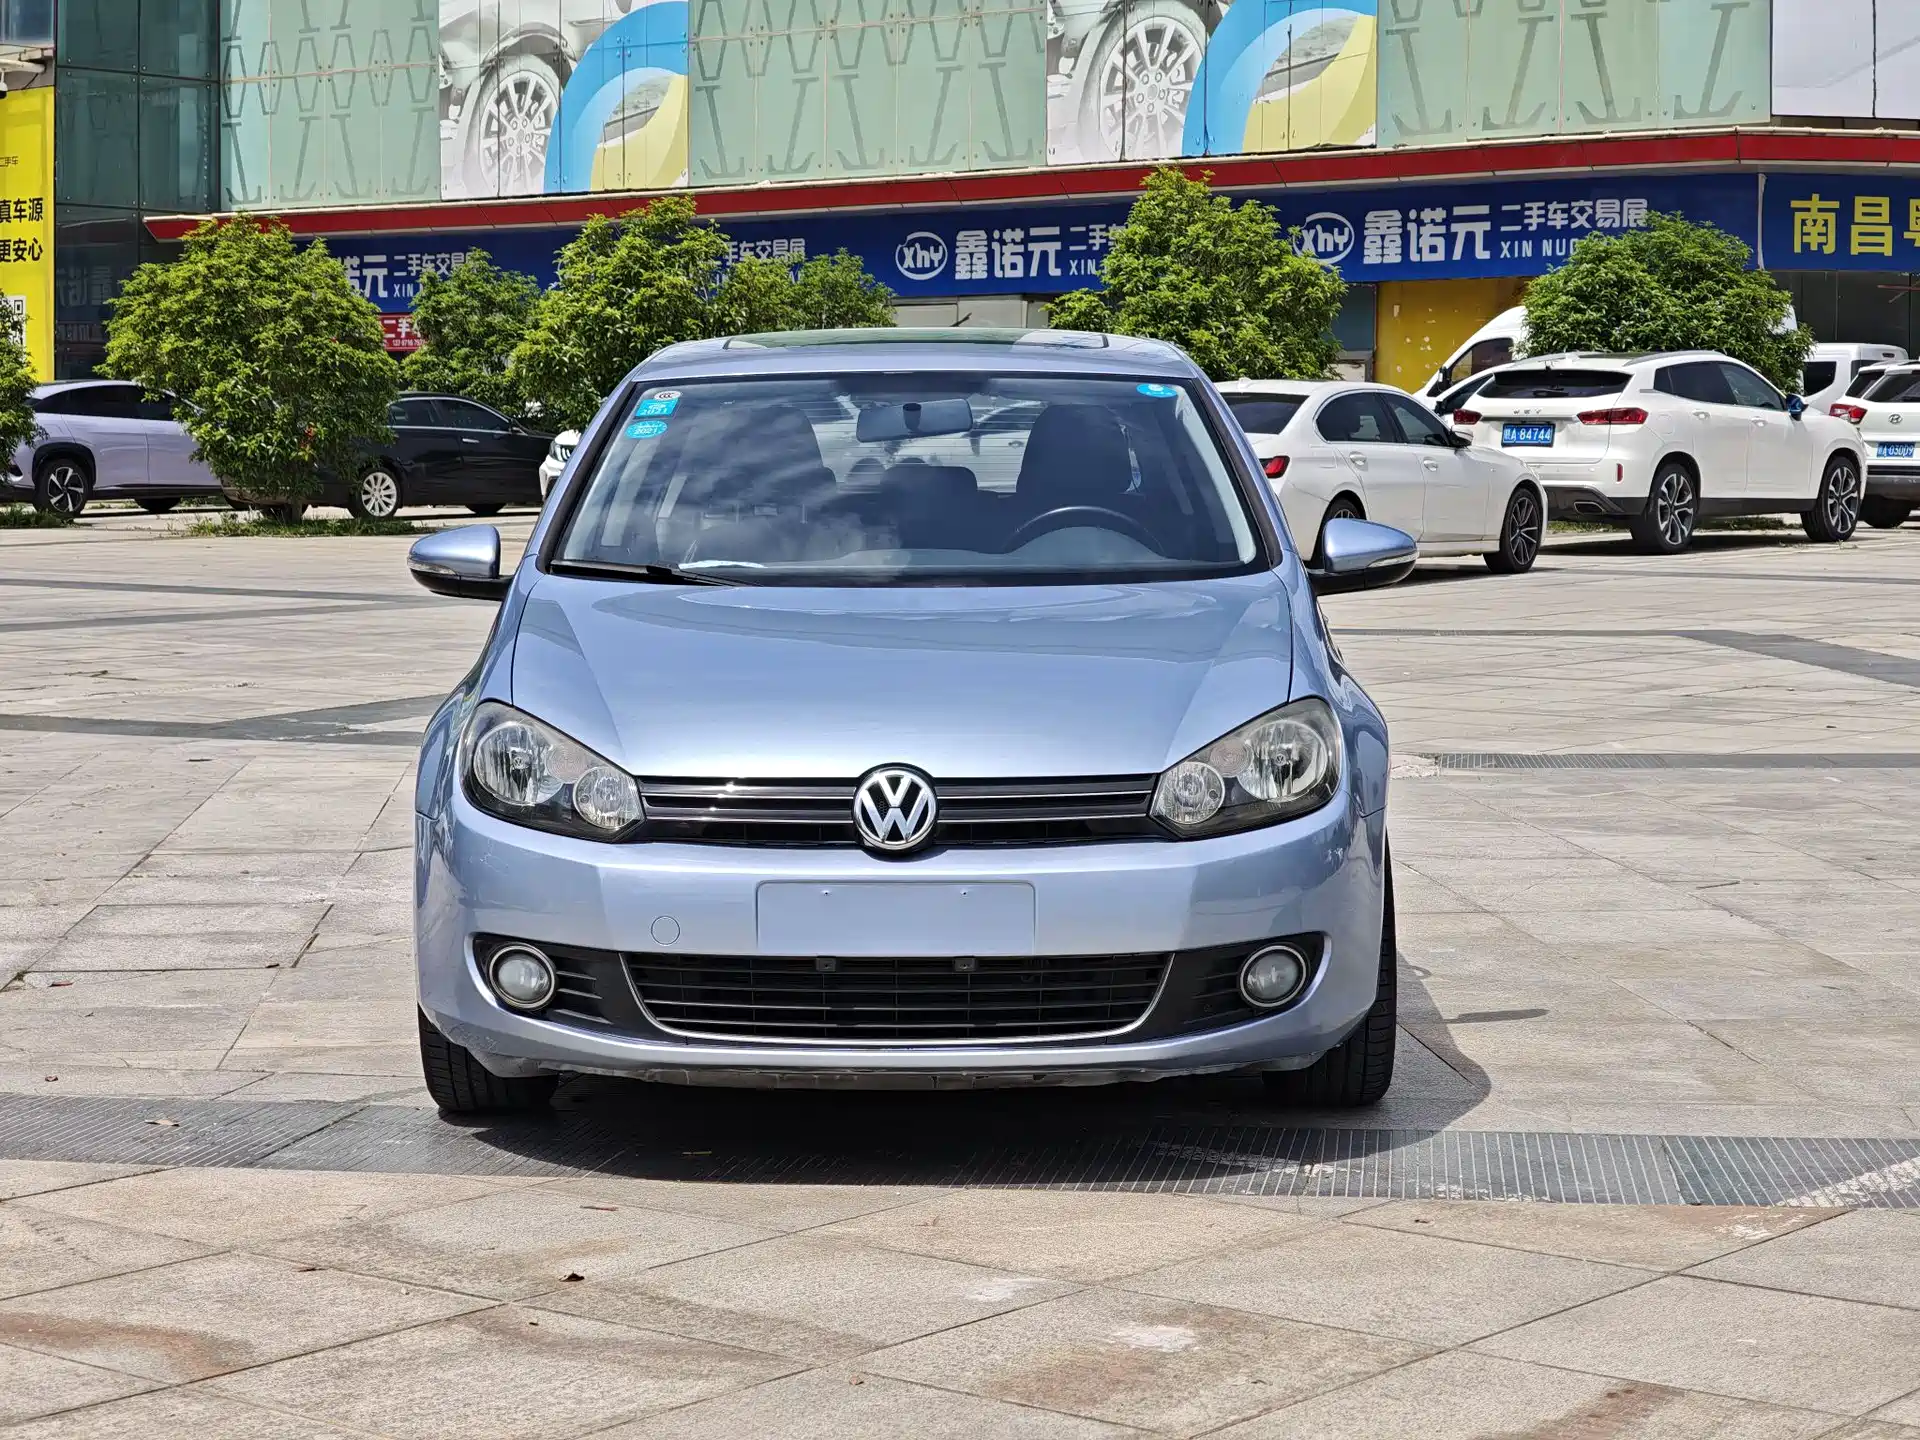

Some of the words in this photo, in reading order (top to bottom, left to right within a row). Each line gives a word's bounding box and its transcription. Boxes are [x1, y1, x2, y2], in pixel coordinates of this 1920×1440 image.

[1500, 198, 1648, 232] 二手车交易展
[1363, 205, 1492, 264] 鑫诺元
[1500, 240, 1533, 259] XIN
[955, 226, 1061, 280] 鑫诺元
[393, 284, 413, 297] XIN
